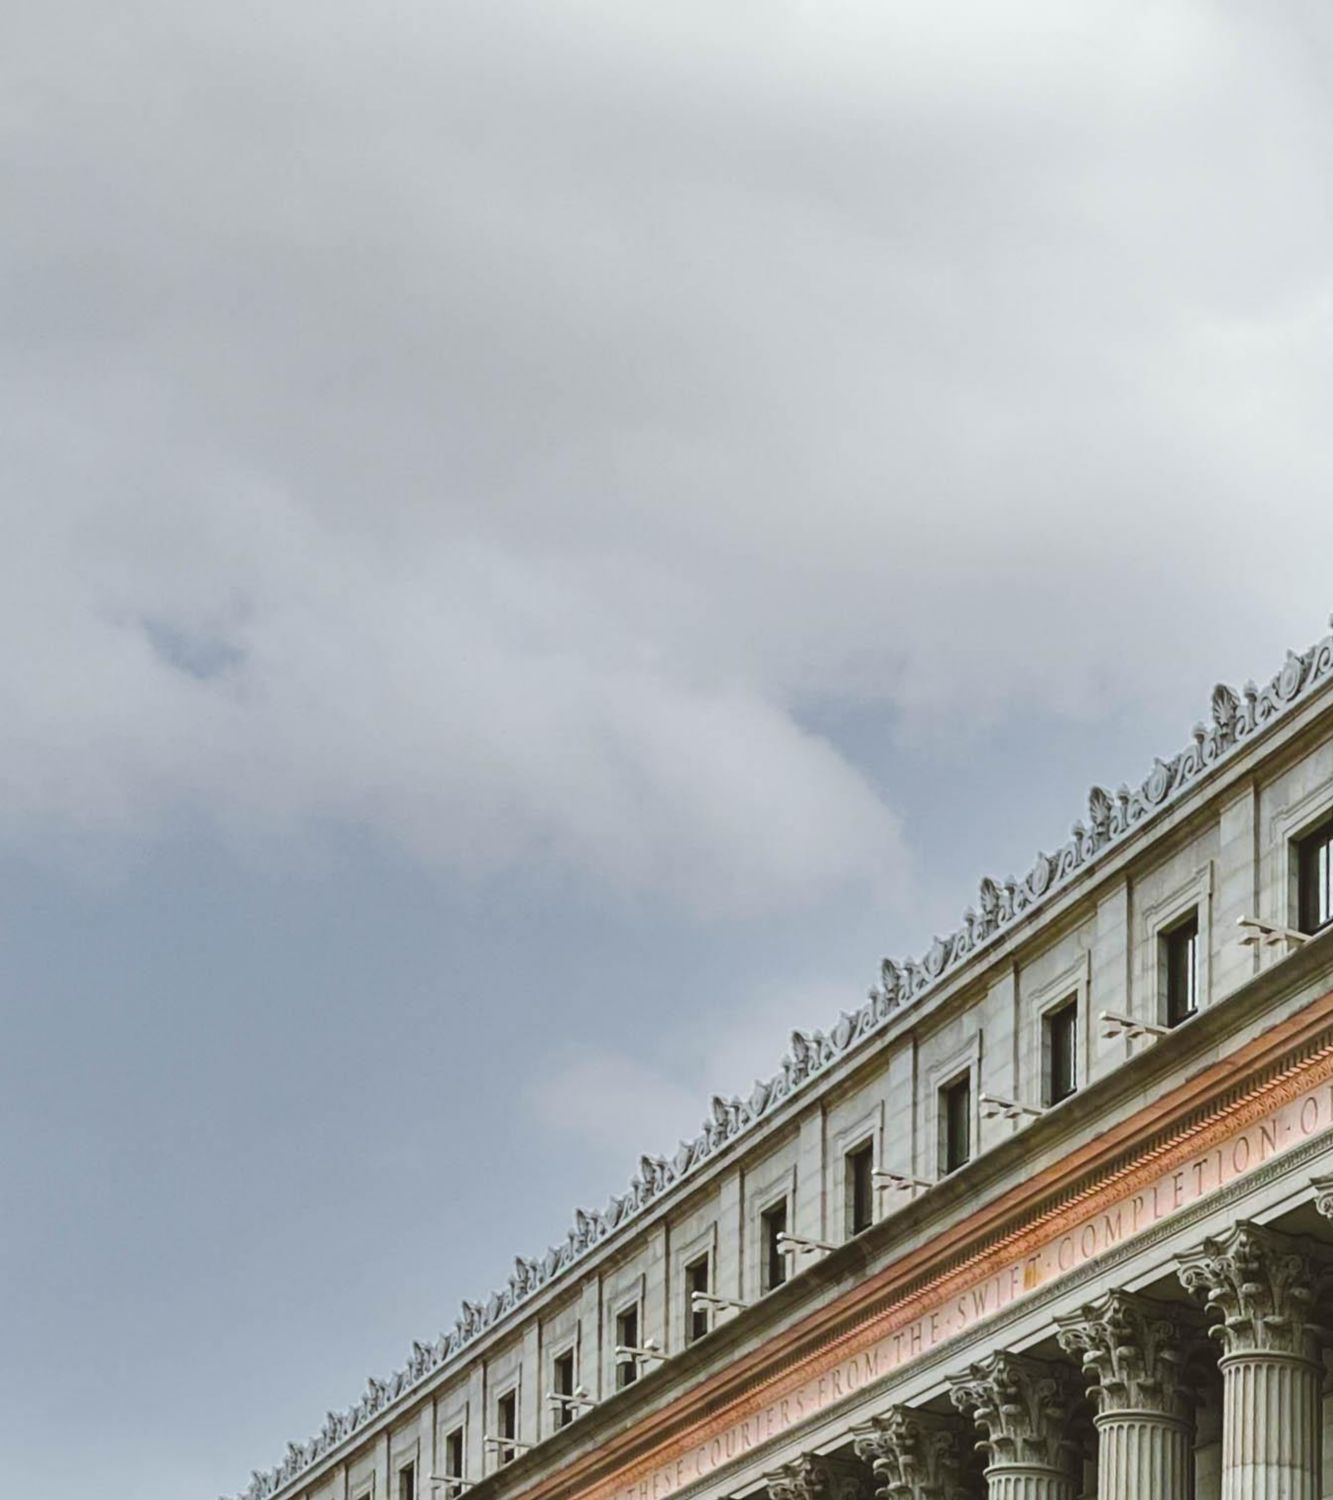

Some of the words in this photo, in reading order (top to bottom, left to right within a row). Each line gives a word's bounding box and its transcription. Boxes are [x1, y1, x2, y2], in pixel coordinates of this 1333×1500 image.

[695, 1391, 805, 1476] COURIERS
[817, 1353, 881, 1408] FROM
[892, 1313, 941, 1364] THE
[957, 1253, 1043, 1330] SWIFT
[1057, 1118, 1281, 1272] COMPLETION
